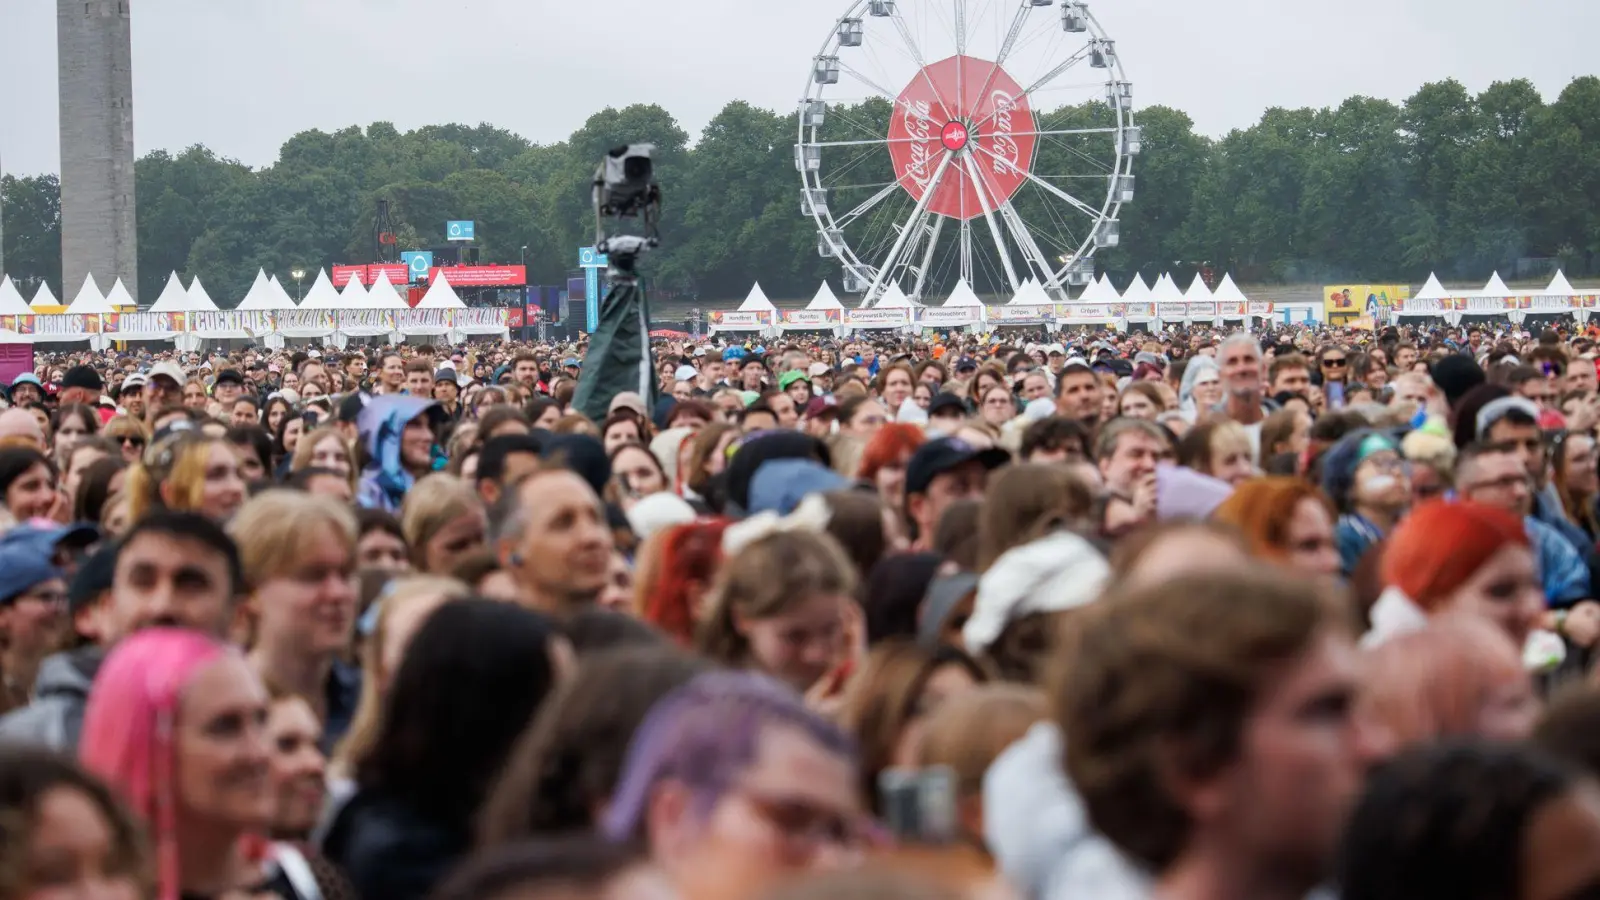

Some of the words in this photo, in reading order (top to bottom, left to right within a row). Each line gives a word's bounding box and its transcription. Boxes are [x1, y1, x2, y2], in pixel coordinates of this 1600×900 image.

[904, 97, 931, 190] CocaCola
[991, 90, 1019, 179] CocaCola
[37, 314, 82, 334] DRINKS
[121, 312, 168, 332] DRINKS
[195, 310, 272, 331] COCKTAILS
[277, 309, 331, 329] COCKTAILS
